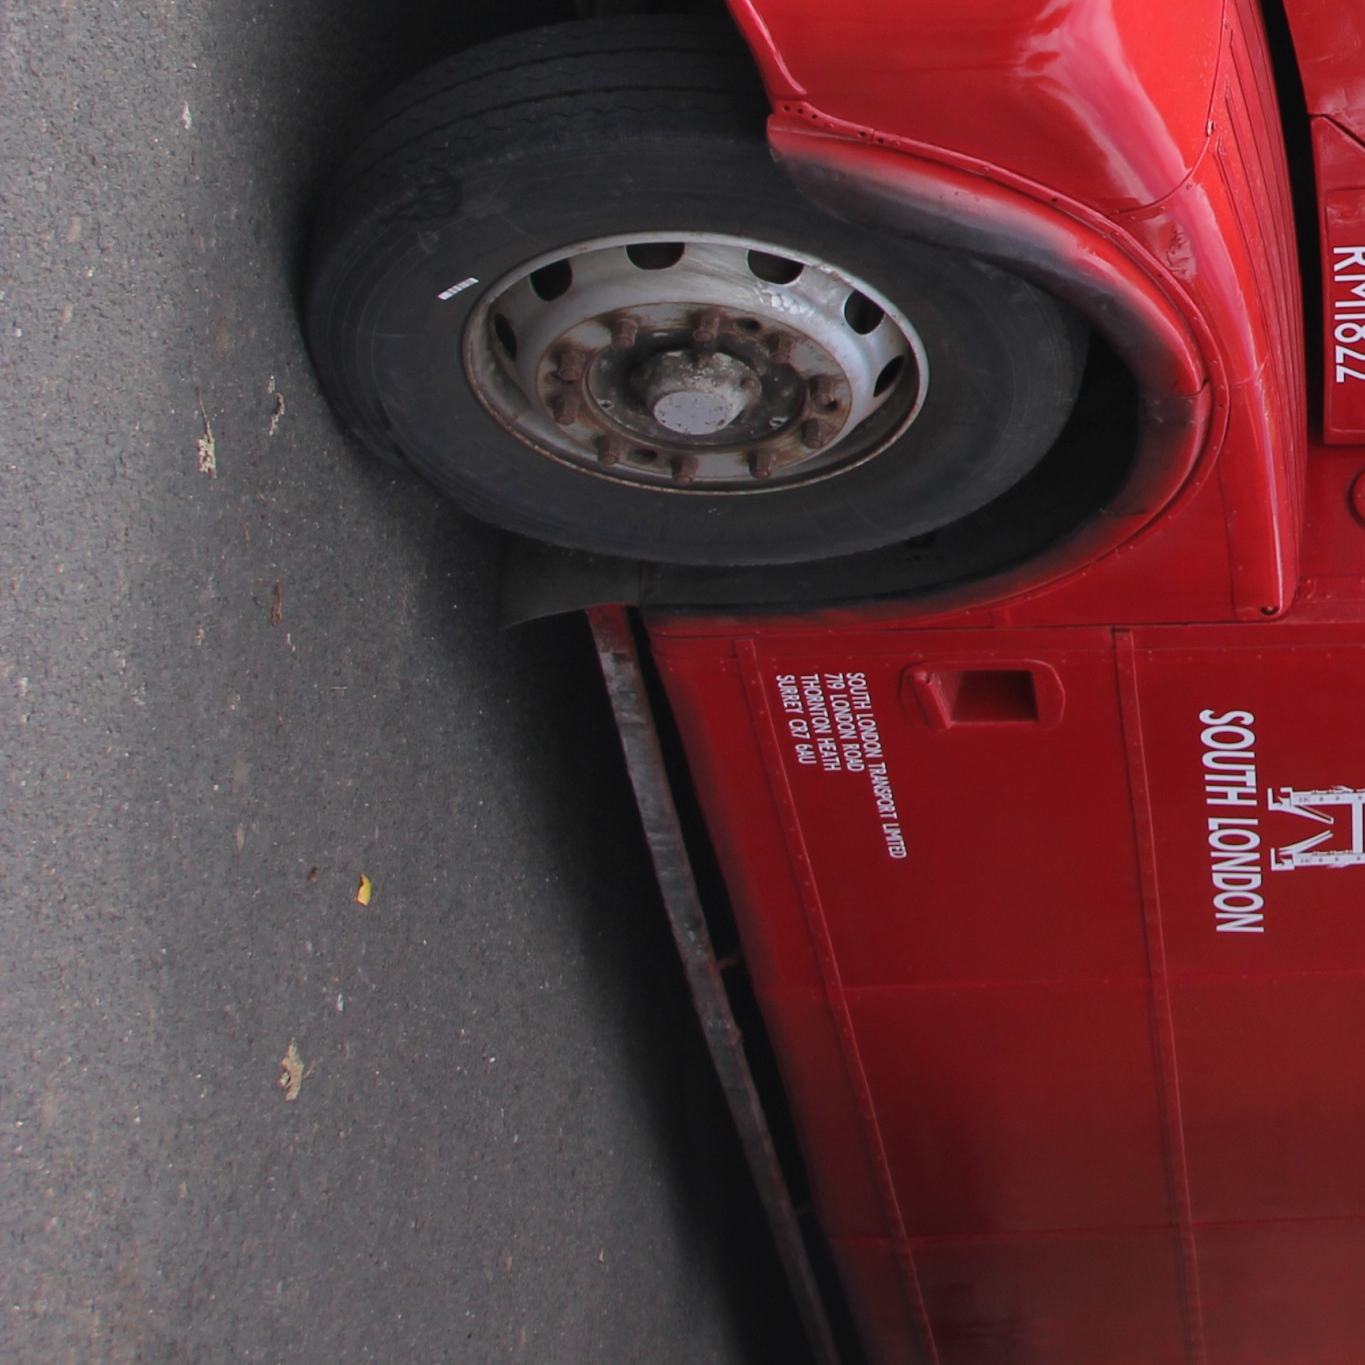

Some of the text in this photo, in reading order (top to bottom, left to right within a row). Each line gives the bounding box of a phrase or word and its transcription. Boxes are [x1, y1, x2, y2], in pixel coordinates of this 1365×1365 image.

[776, 674, 816, 764] SURREY CR7 6AU
[801, 674, 841, 771] THORNTON HEATH
[824, 673, 865, 772] 719 LONDON ROAD
[846, 673, 907, 858] SOUTH LONDON TRANSPORT LIMITED
[1198, 709, 1264, 933] SOUTH LONDON
